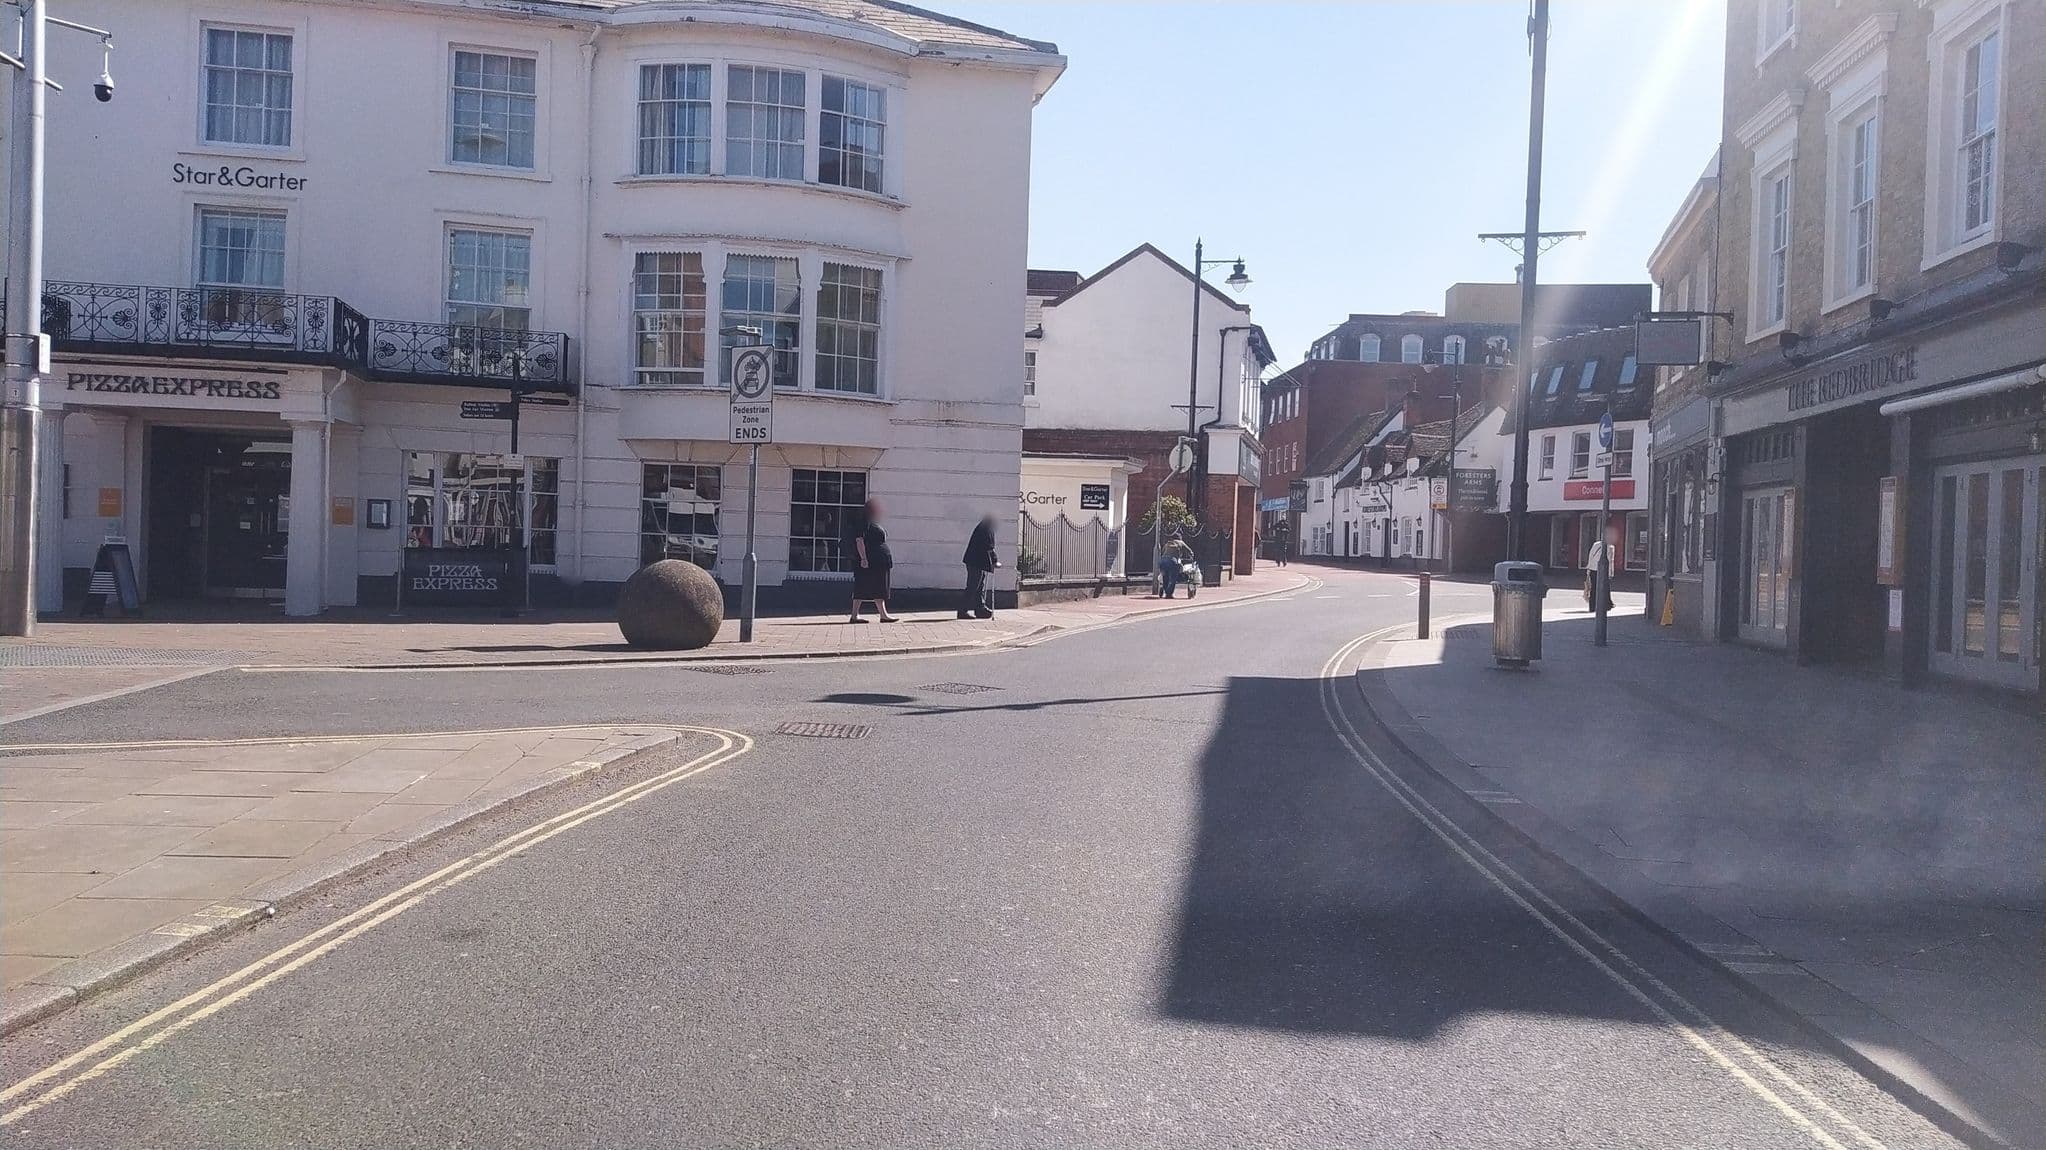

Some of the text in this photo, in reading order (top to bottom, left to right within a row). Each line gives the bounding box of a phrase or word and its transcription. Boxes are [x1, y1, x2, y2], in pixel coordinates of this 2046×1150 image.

[173, 162, 308, 191] Star&Garter
[1785, 379, 1817, 412] THE
[732, 406, 770, 414] Pedestrian
[742, 415, 759, 423] Zone
[735, 427, 767, 439] ENDS
[428, 564, 483, 577] PIZZA
[412, 577, 498, 590] EXPRESS
